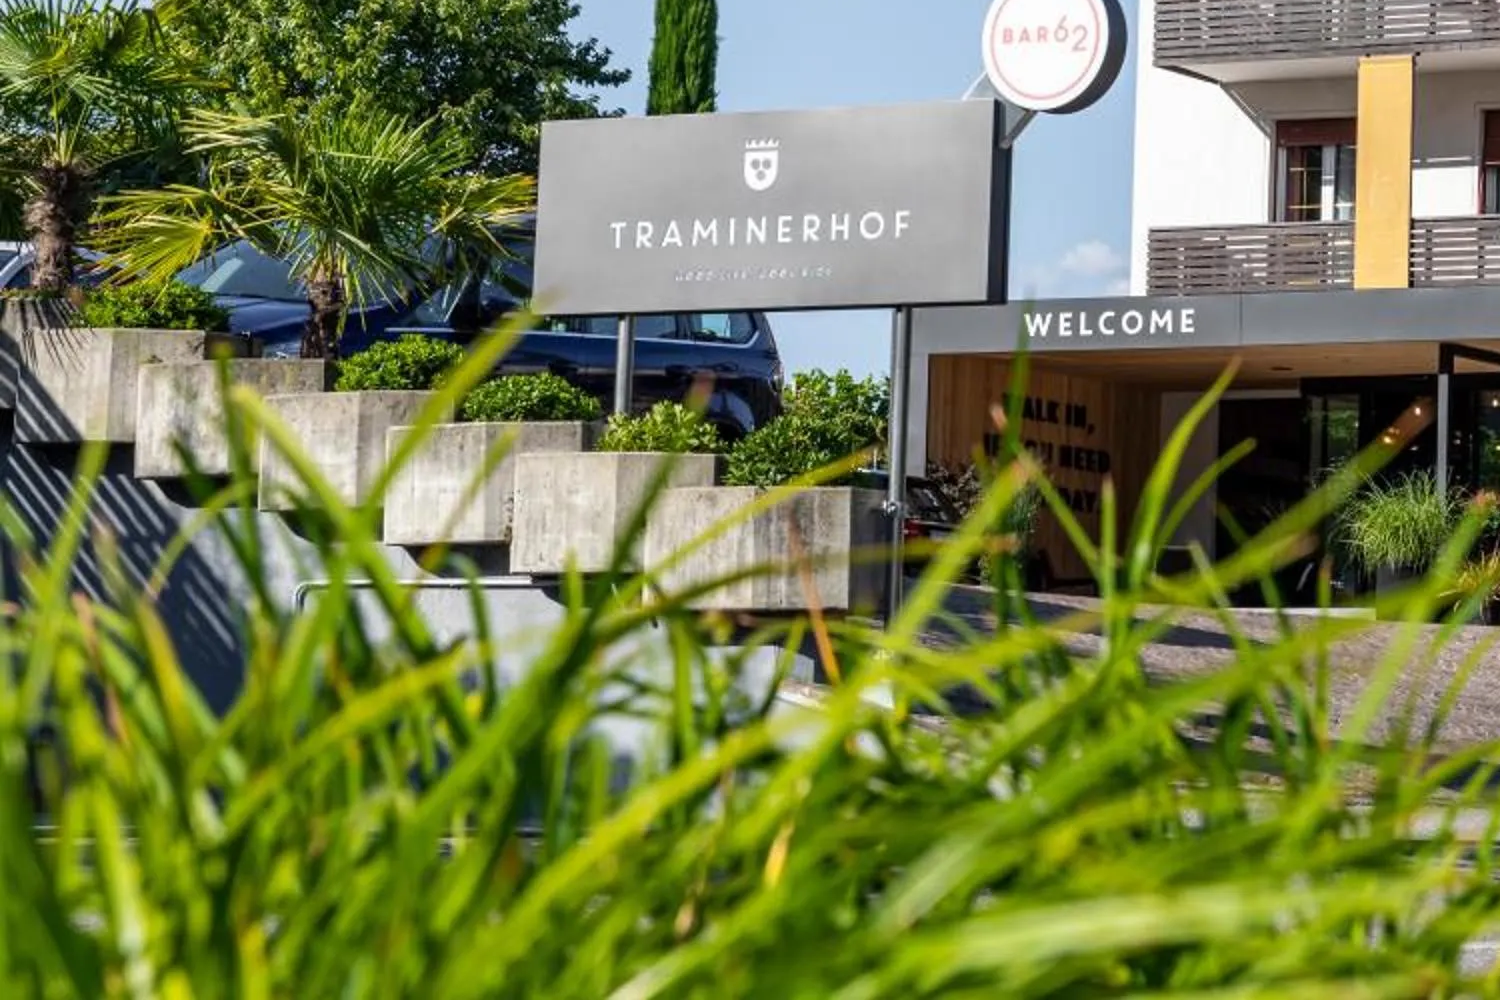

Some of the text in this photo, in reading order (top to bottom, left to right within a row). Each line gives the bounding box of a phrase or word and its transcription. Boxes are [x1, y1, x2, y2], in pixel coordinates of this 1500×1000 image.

[610, 209, 912, 250] TRAMINERHOF
[1024, 308, 1196, 337] WELCOME
[1002, 391, 1059, 424] ALK
[1059, 445, 1111, 474] NEED
